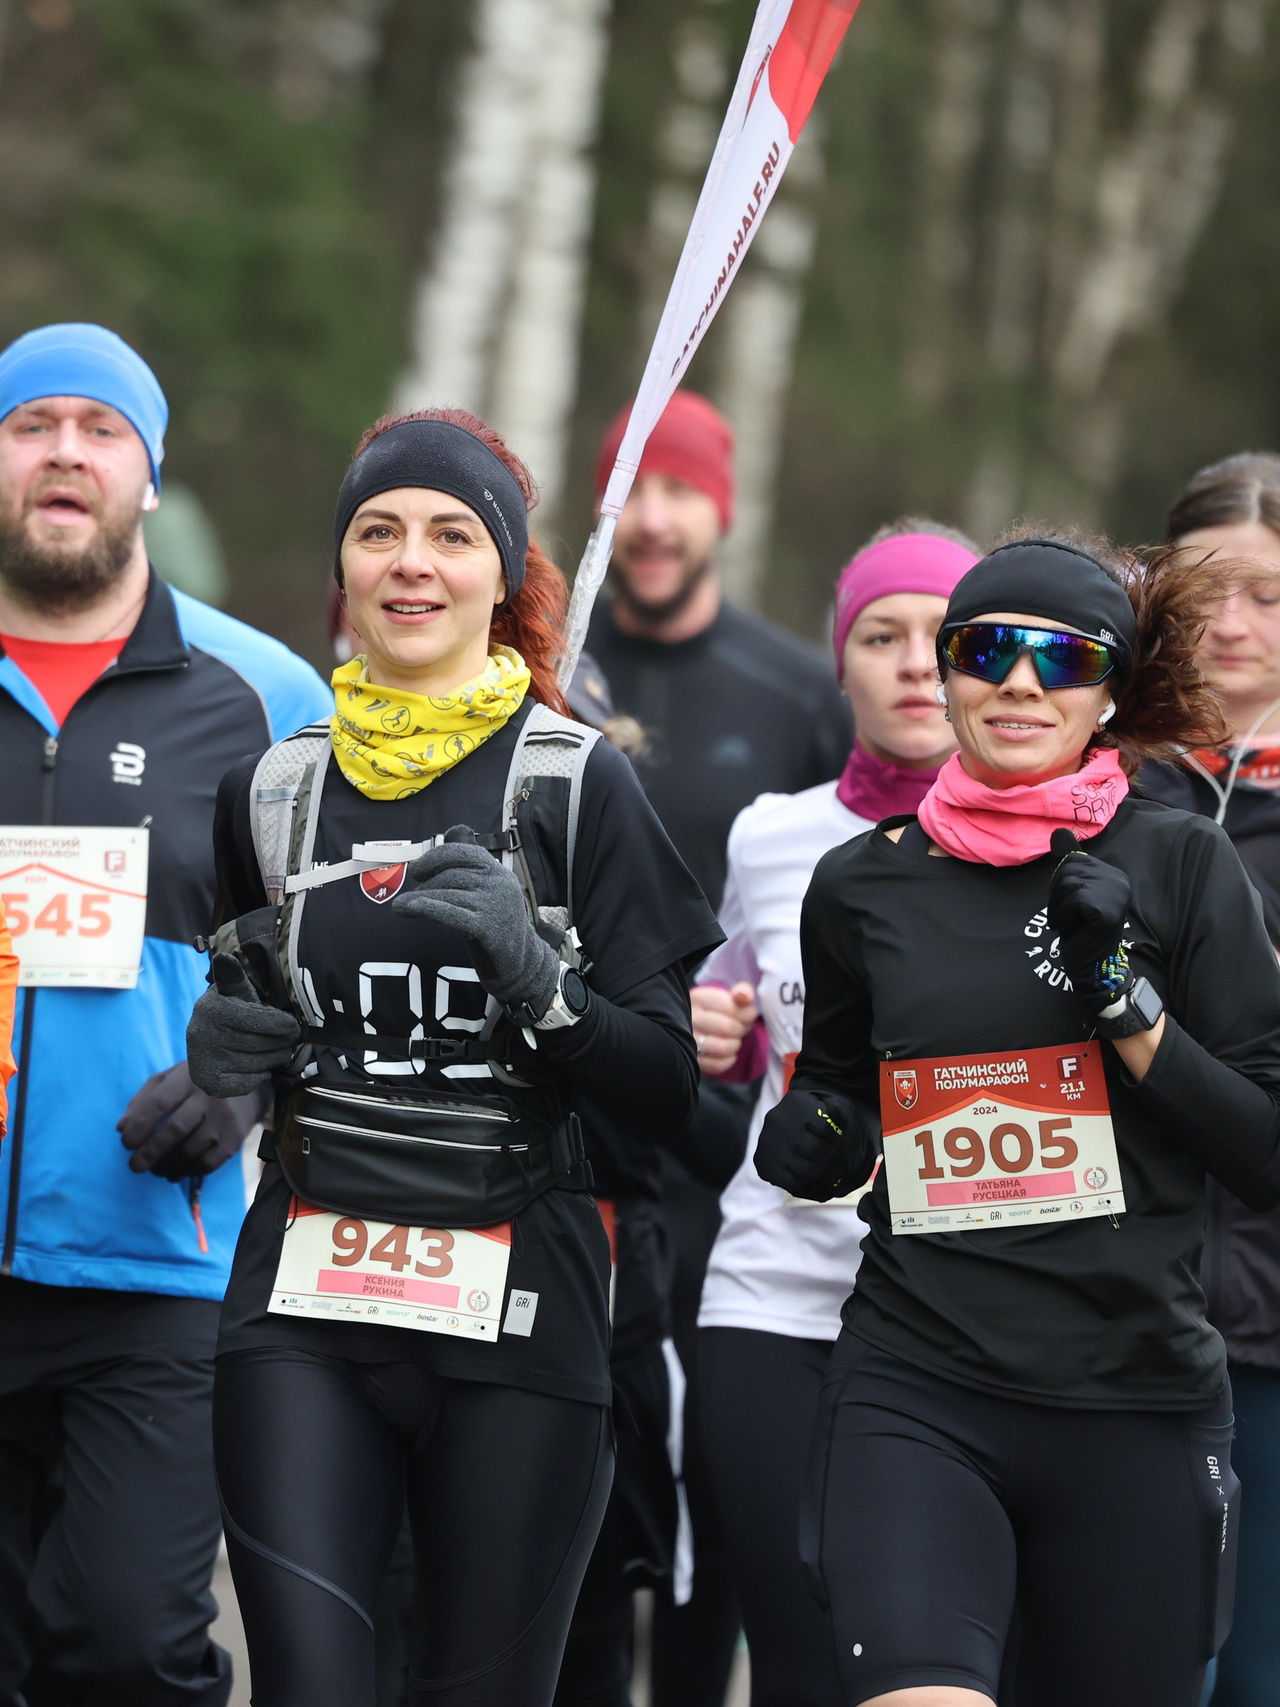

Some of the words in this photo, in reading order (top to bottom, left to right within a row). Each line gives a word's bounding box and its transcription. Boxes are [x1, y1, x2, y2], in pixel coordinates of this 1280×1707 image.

[300, 961, 495, 1080] :09
[933, 1058, 1028, 1080] ГАТЧИНСКИЙ
[1062, 1057, 1077, 1078] F
[935, 1073, 1029, 1091] ПОЛУМАРАФОН
[1060, 1081, 1086, 1094] 21.1
[973, 1106, 998, 1116] 2024
[915, 1117, 1079, 1180] 1905
[975, 1179, 1021, 1190] ТАТЬЯНА
[972, 1188, 1027, 1201] РУСЕЦКАЯ
[332, 1217, 455, 1279] 943
[365, 1275, 405, 1288] КСЕНИЯ
[362, 1286, 404, 1298] РУКИНА
[516, 1297, 530, 1309] GRi
